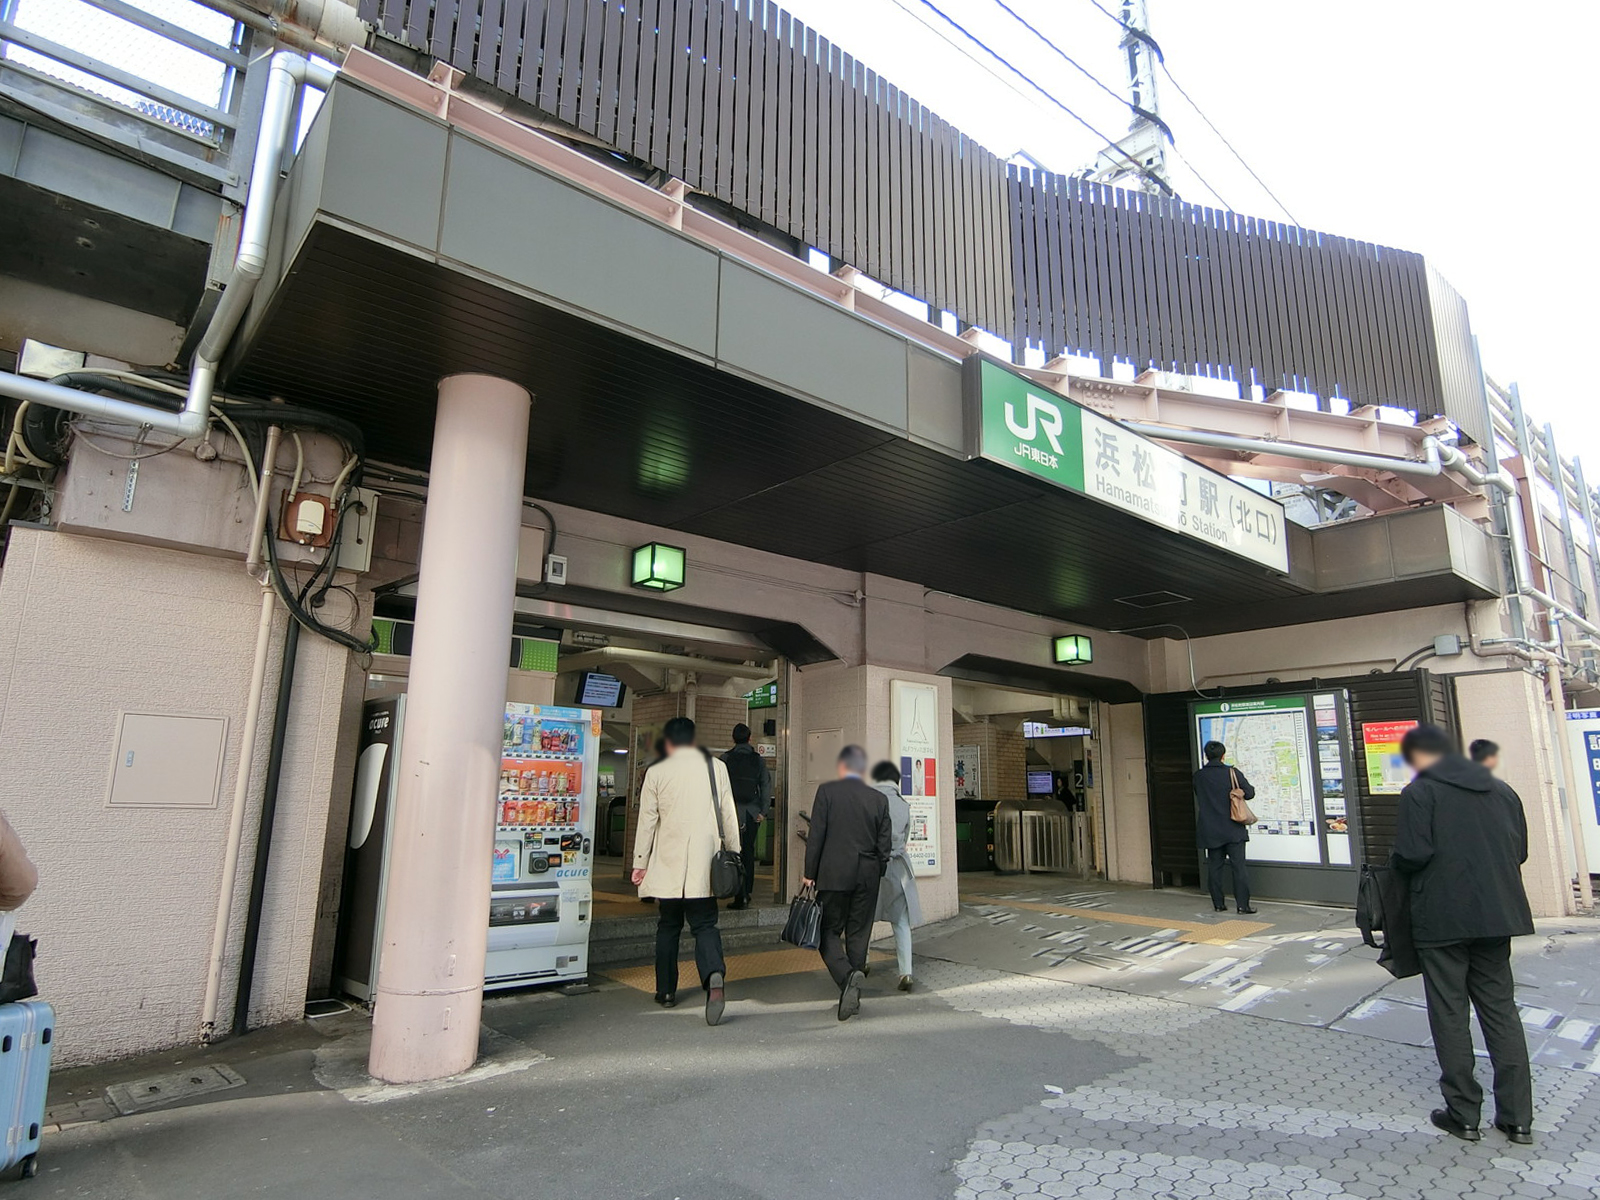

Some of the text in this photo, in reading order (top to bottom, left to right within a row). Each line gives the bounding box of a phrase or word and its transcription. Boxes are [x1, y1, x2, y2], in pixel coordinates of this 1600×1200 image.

[1005, 392, 1064, 456] JR
[1014, 442, 1059, 469] JR東日本
[1192, 515, 1228, 542] Station
[369, 717, 389, 730] acure
[1075, 773, 1084, 788] 2
[556, 868, 589, 878] acure
